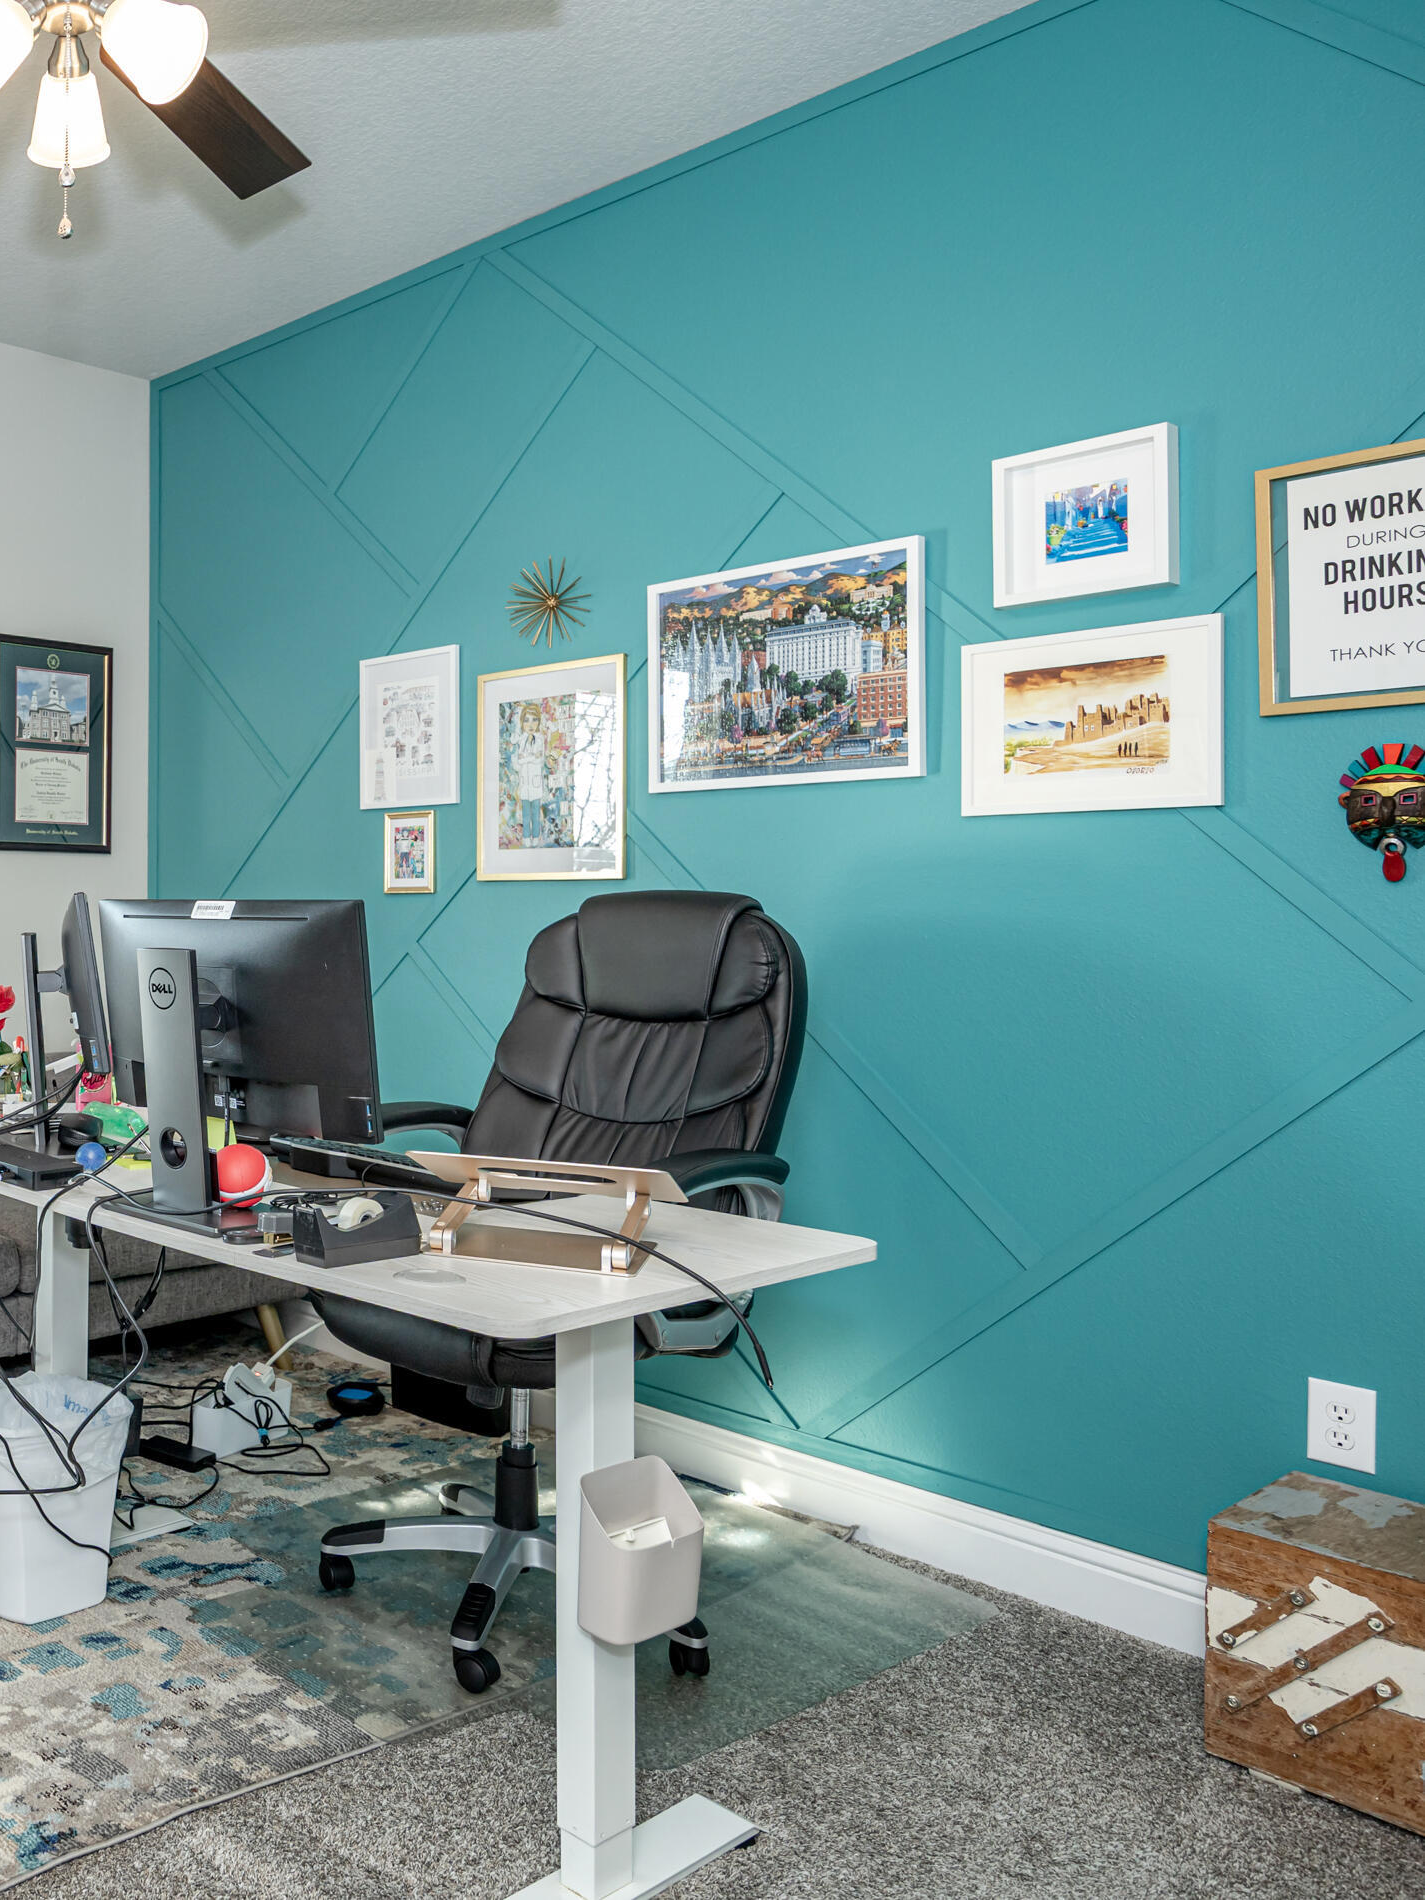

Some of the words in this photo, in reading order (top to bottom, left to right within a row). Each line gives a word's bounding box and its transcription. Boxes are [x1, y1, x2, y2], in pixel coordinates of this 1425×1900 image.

[1303, 503, 1336, 531] NO
[1344, 487, 1424, 523] WORK
[1346, 524, 1425, 549] DURING
[1343, 580, 1425, 615] HOURS
[1329, 642, 1396, 662] THANK
[151, 982, 173, 994] DELL
